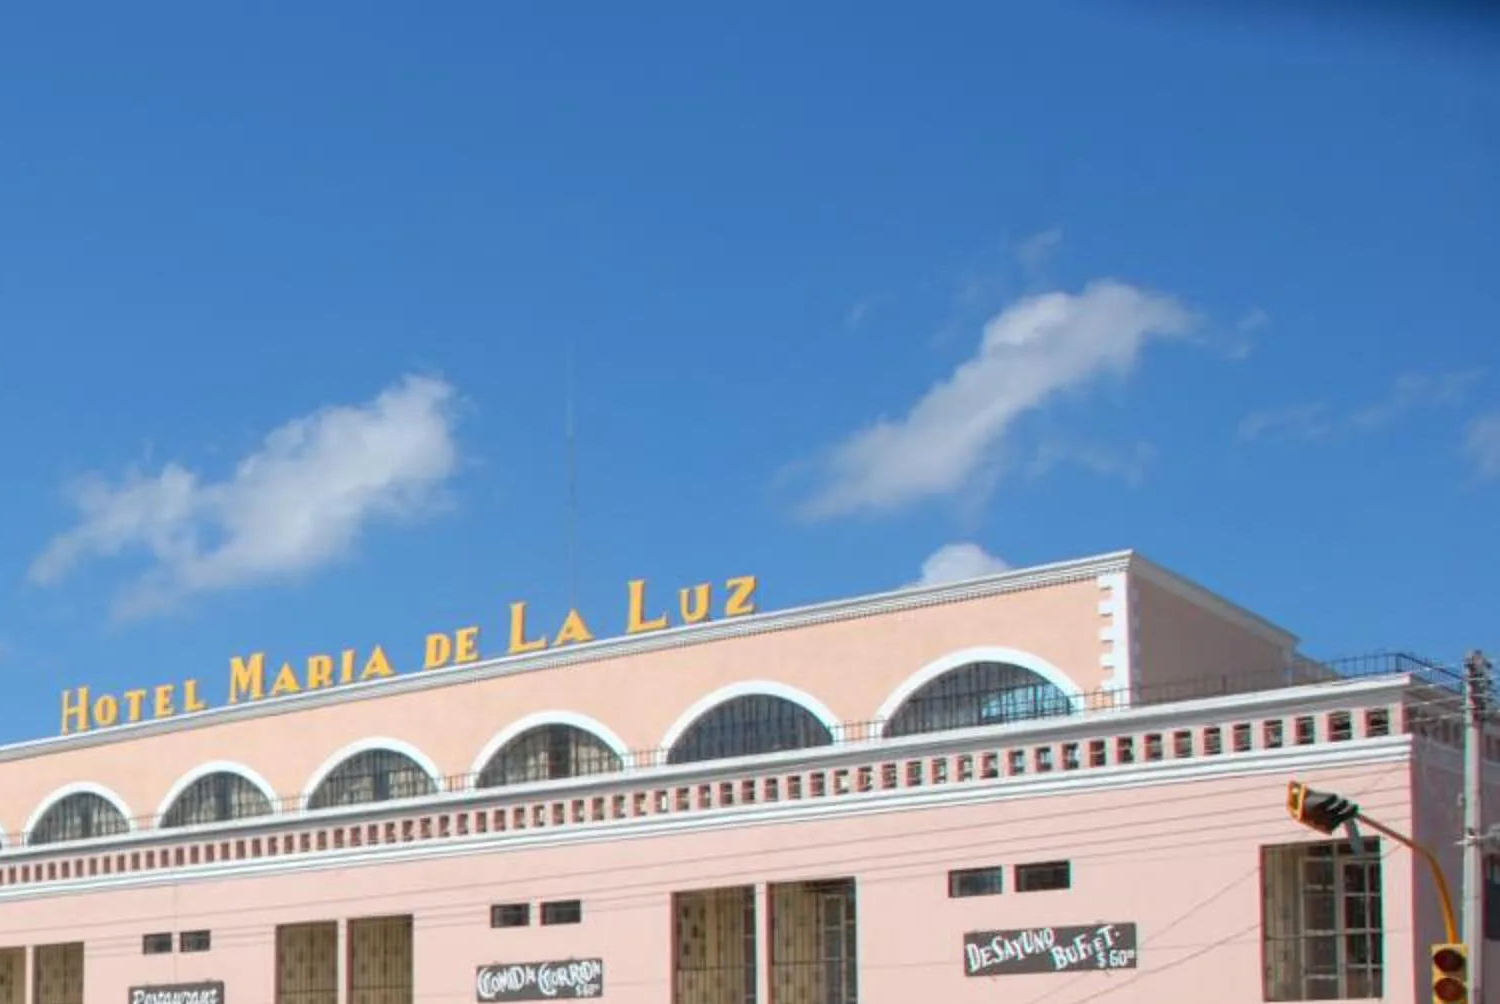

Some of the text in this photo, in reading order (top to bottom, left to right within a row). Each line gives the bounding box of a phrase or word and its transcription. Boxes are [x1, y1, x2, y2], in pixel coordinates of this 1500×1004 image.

[424, 626, 479, 670] DE
[508, 600, 595, 654] LA
[626, 575, 757, 635] LUZ
